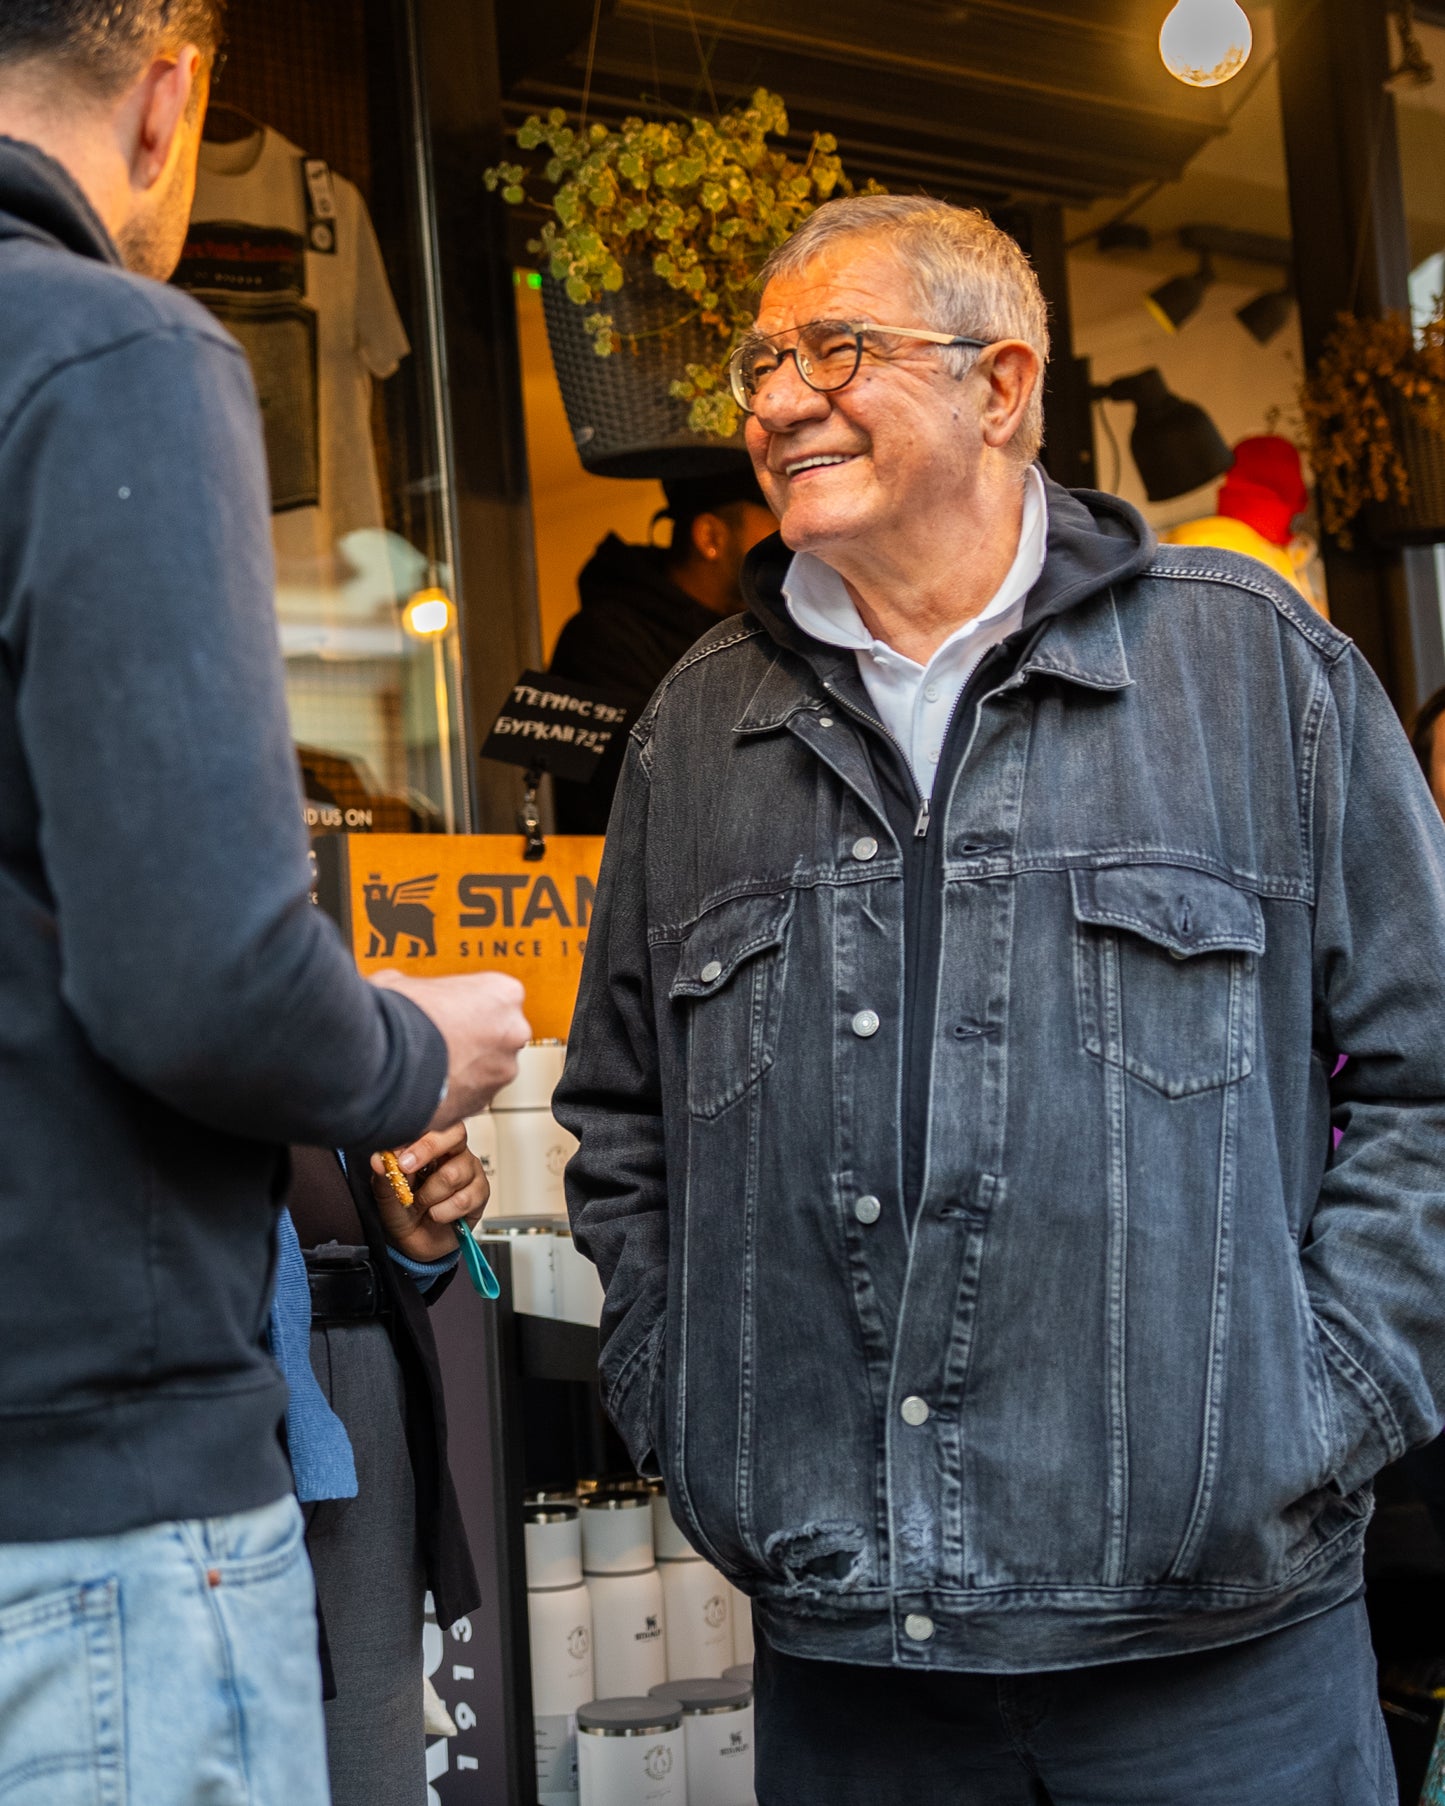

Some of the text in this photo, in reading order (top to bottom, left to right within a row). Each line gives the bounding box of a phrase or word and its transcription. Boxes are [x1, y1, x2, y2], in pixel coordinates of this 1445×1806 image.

[320, 808, 343, 826] US
[344, 808, 373, 827] ON
[459, 940, 542, 957] SINCE
